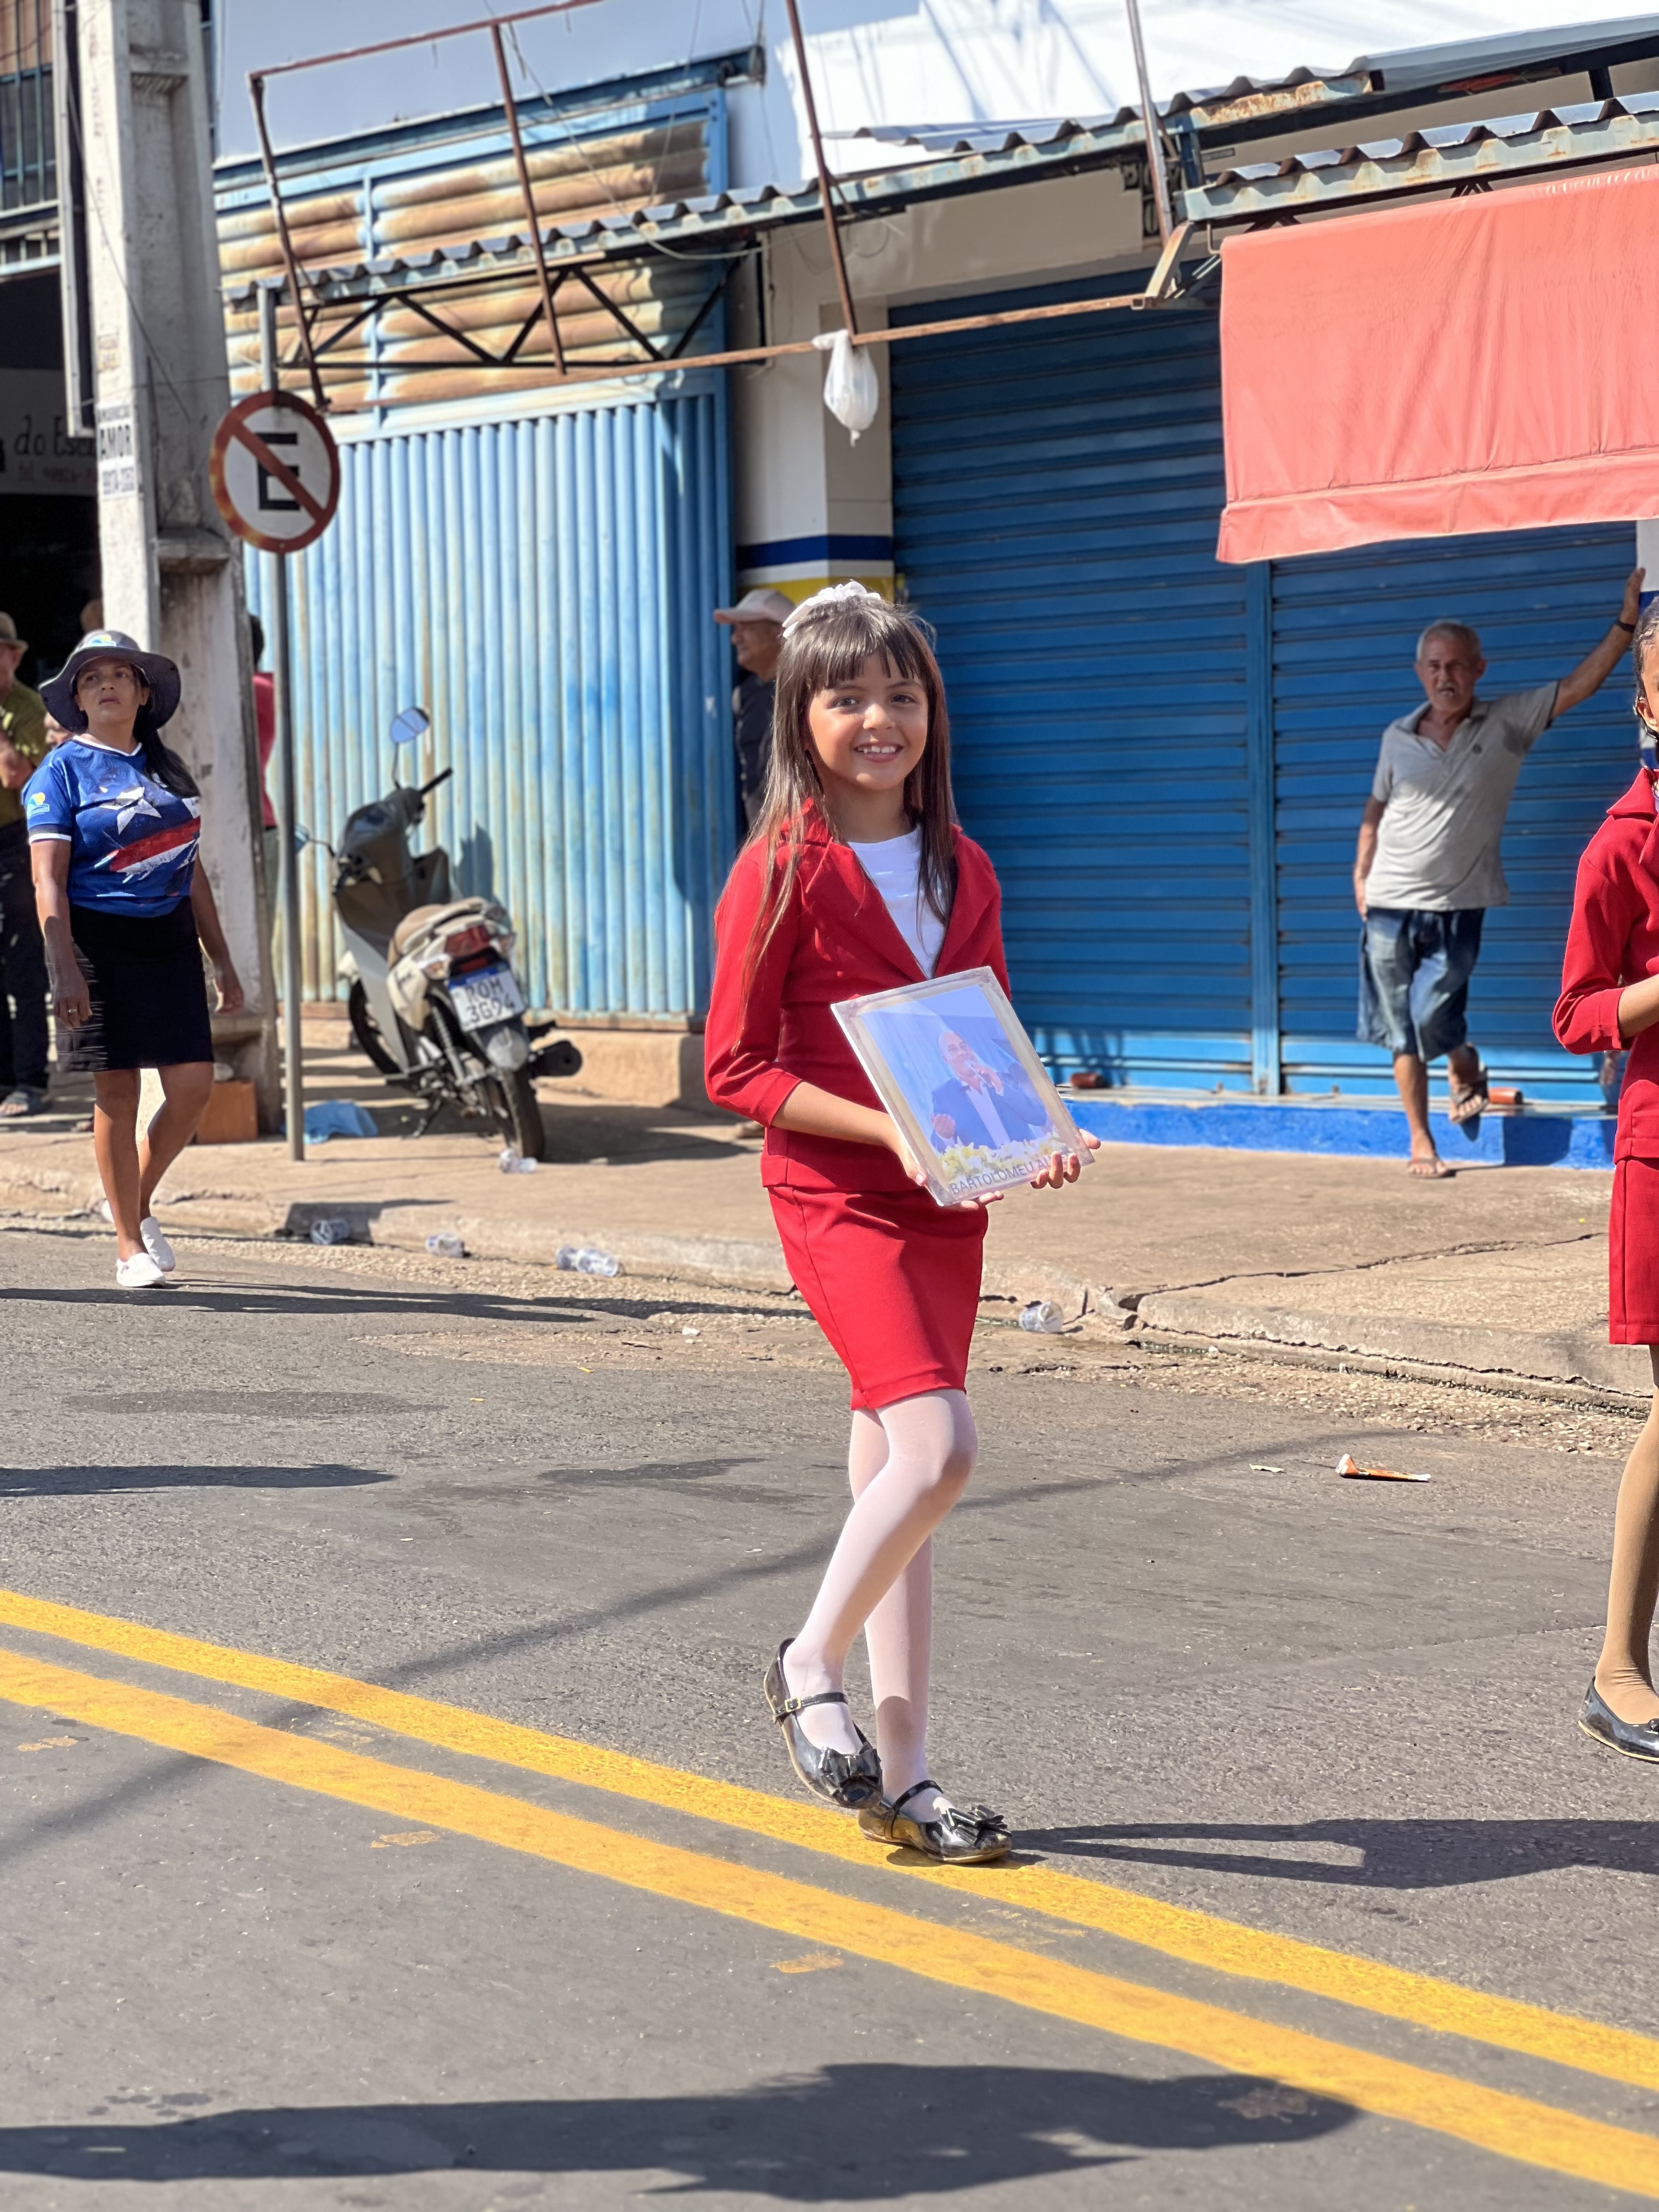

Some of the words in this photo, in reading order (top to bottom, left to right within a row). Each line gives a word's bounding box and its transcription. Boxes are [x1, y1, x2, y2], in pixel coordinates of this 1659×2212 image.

[255, 432, 301, 511] E
[466, 992, 515, 1024] 3G94
[949, 1161, 1034, 1194] BARTOLOMEU
